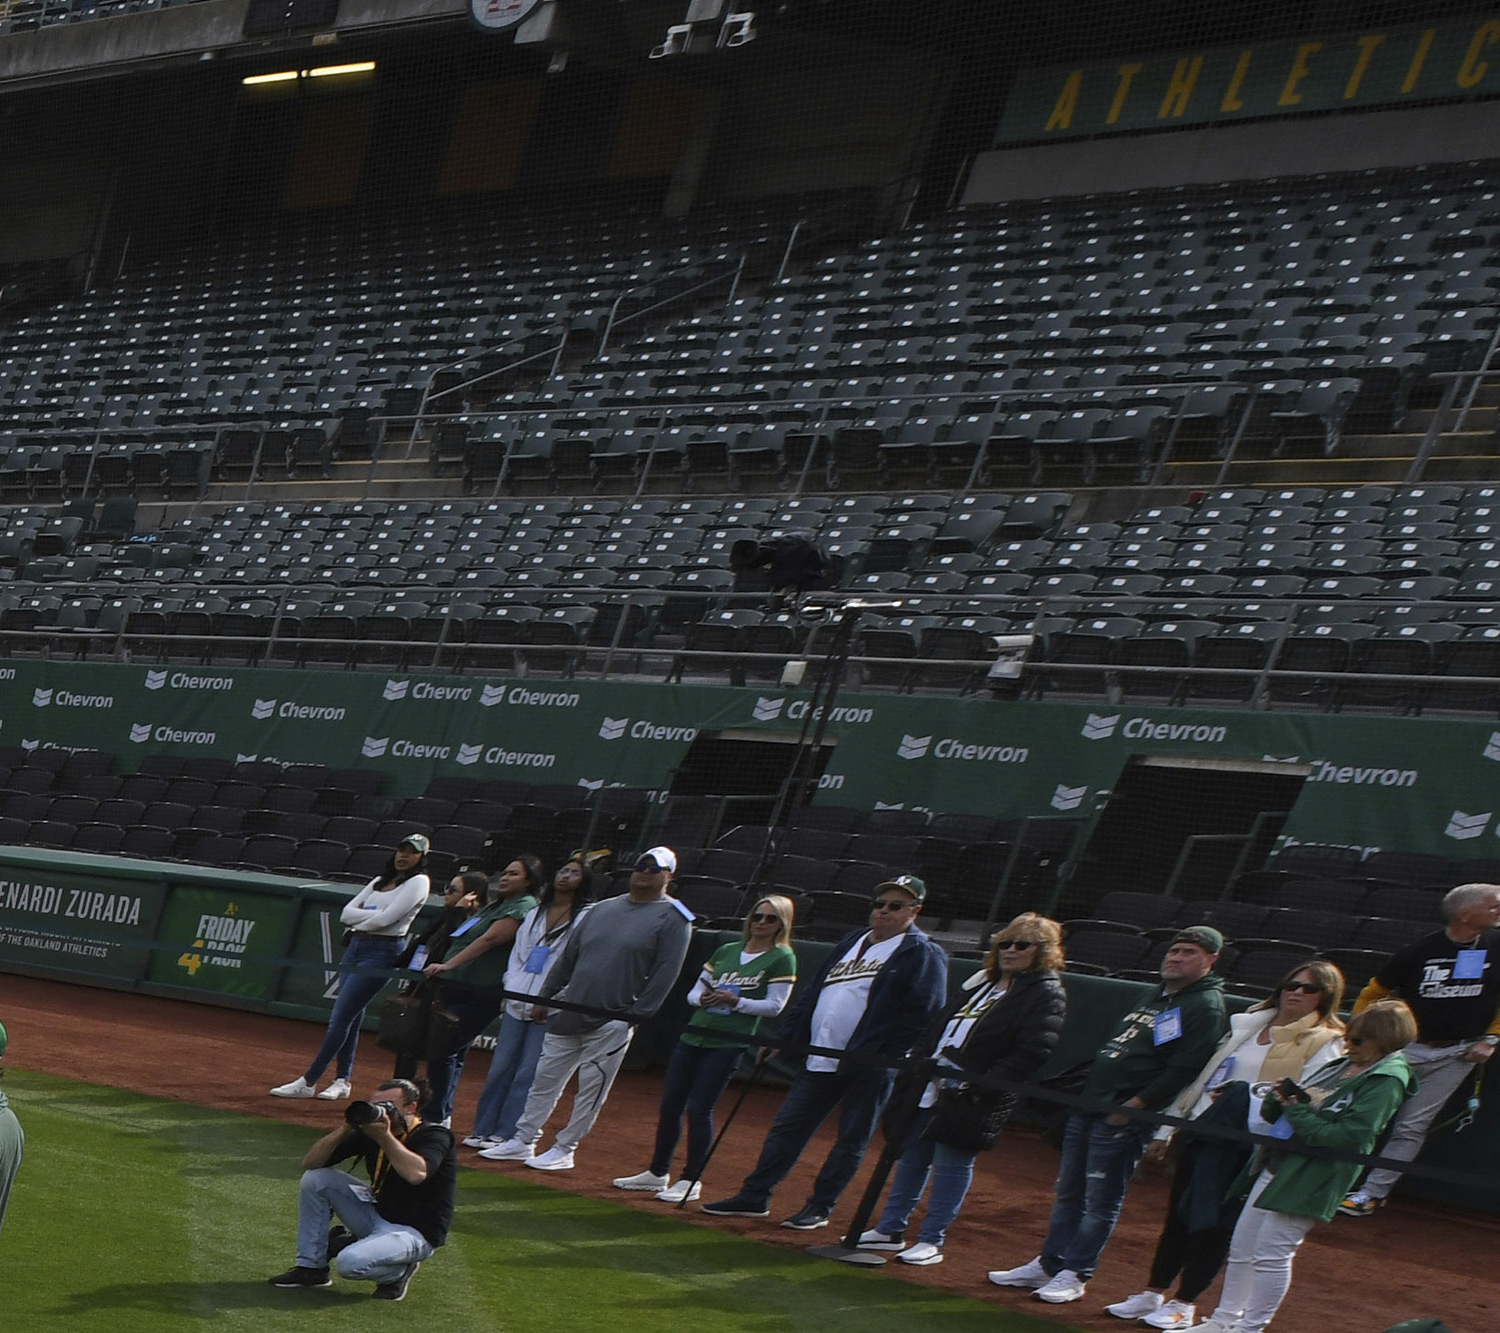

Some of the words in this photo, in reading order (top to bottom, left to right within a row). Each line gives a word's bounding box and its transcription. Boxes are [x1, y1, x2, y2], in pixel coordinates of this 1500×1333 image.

[169, 673, 234, 693] Chevron
[412, 683, 471, 702] Chevro
[55, 691, 115, 709] Chevron
[508, 687, 580, 709] Chevron
[278, 702, 346, 722] Chevron
[154, 726, 216, 746] Chevron
[629, 720, 696, 743] Chevro
[1122, 716, 1226, 743] Chevron
[392, 737, 450, 759] Chevro
[484, 742, 556, 768] Chevron
[933, 738, 1029, 764] Chevron
[64, 892, 141, 927] ZURADA
[195, 914, 255, 944] FRIDAY
[6, 934, 22, 947] THE
[23, 937, 62, 953] OAKLAND
[62, 942, 108, 958] ATHLETICS
